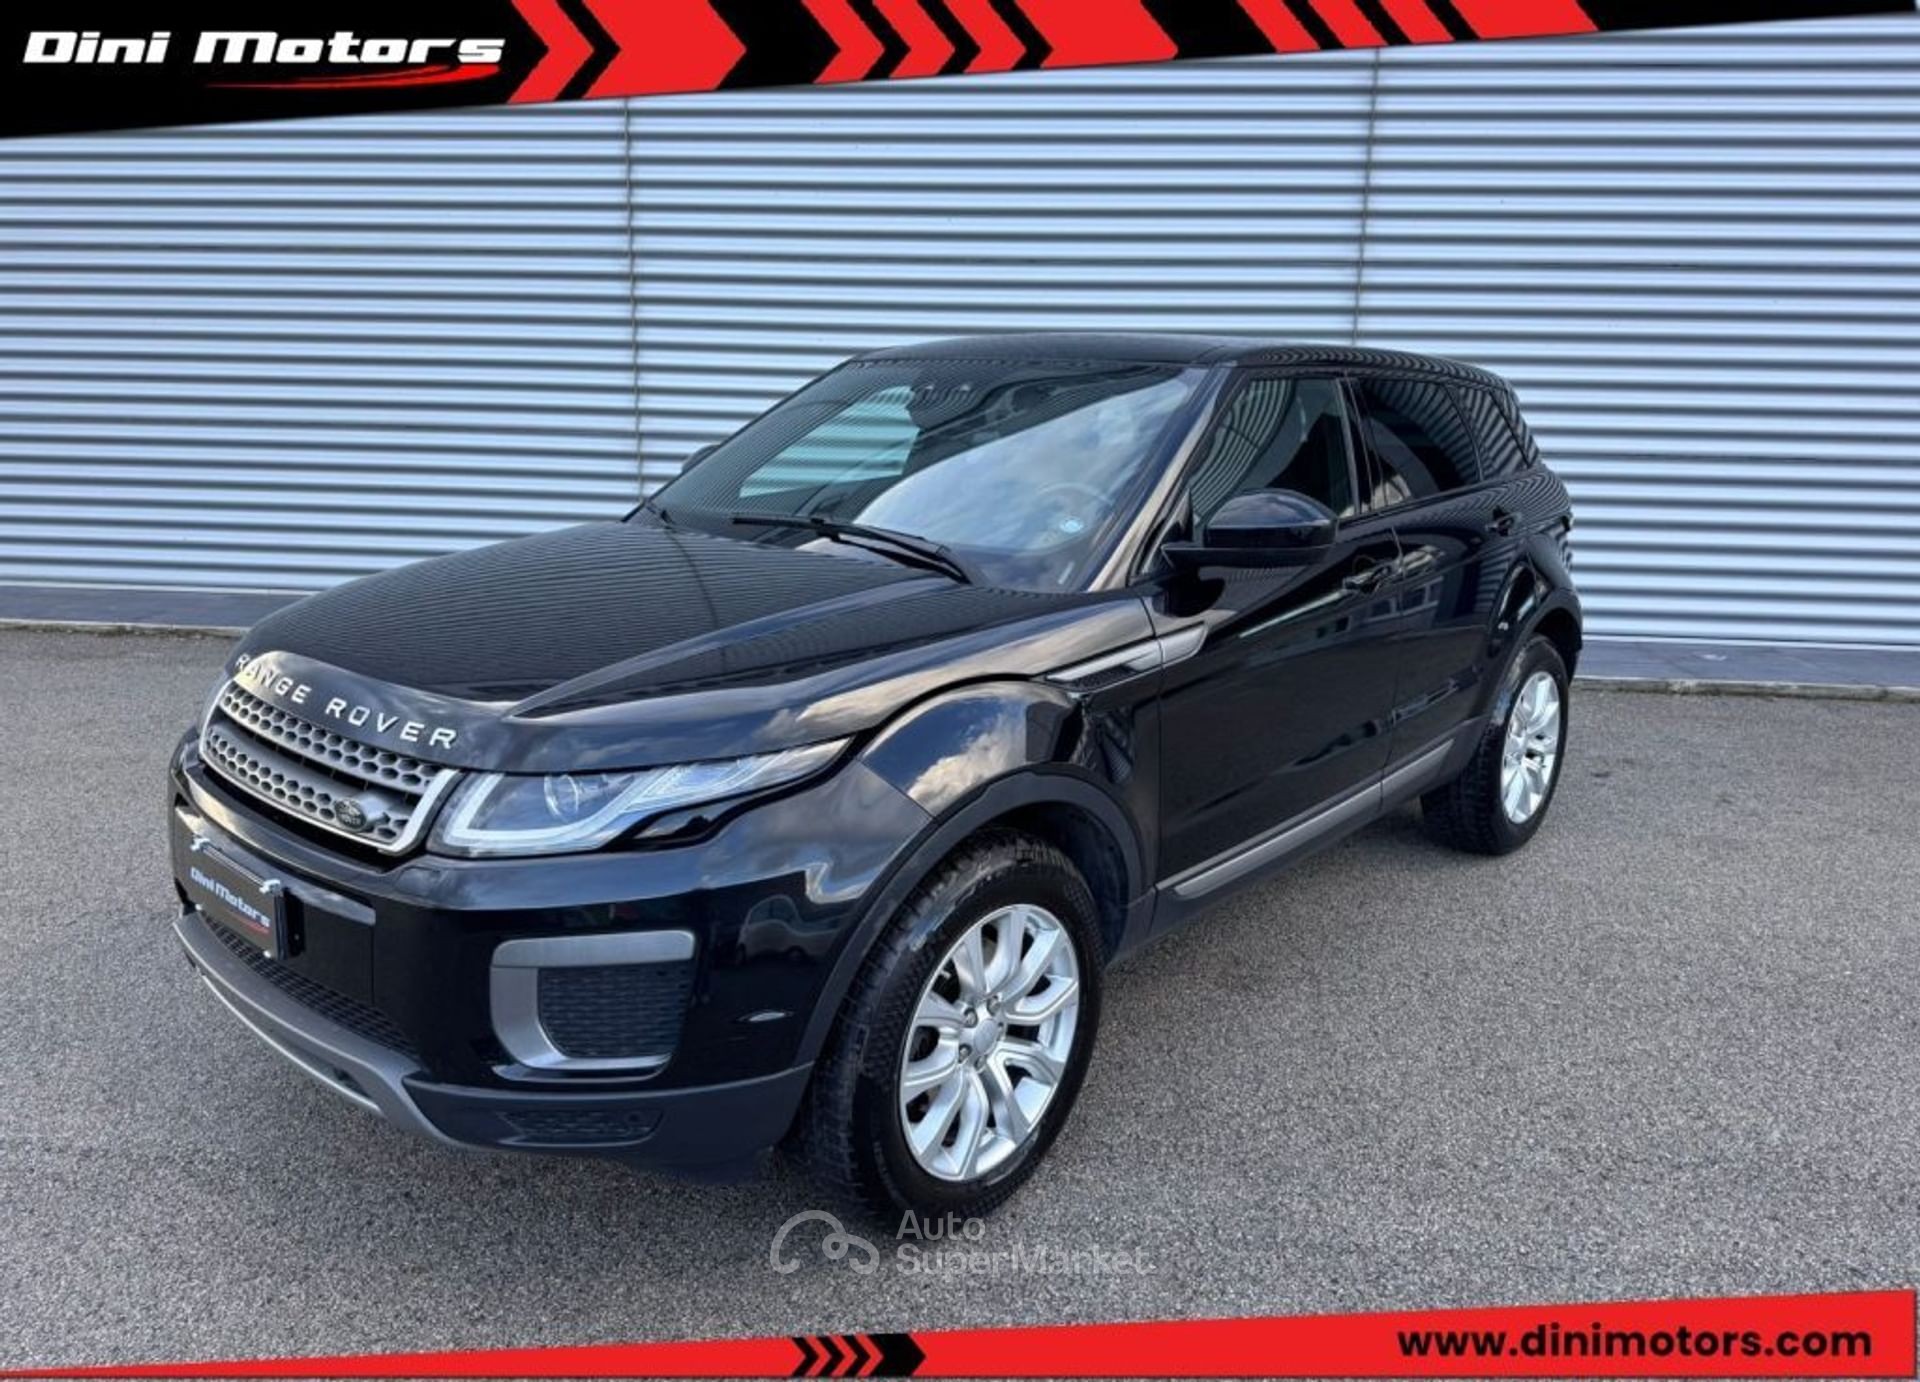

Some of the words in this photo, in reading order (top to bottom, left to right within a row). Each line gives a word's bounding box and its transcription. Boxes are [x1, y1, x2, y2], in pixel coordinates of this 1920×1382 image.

[234, 653, 313, 705] RANGE
[325, 697, 458, 750] ROVER
[215, 882, 271, 928] Motors
